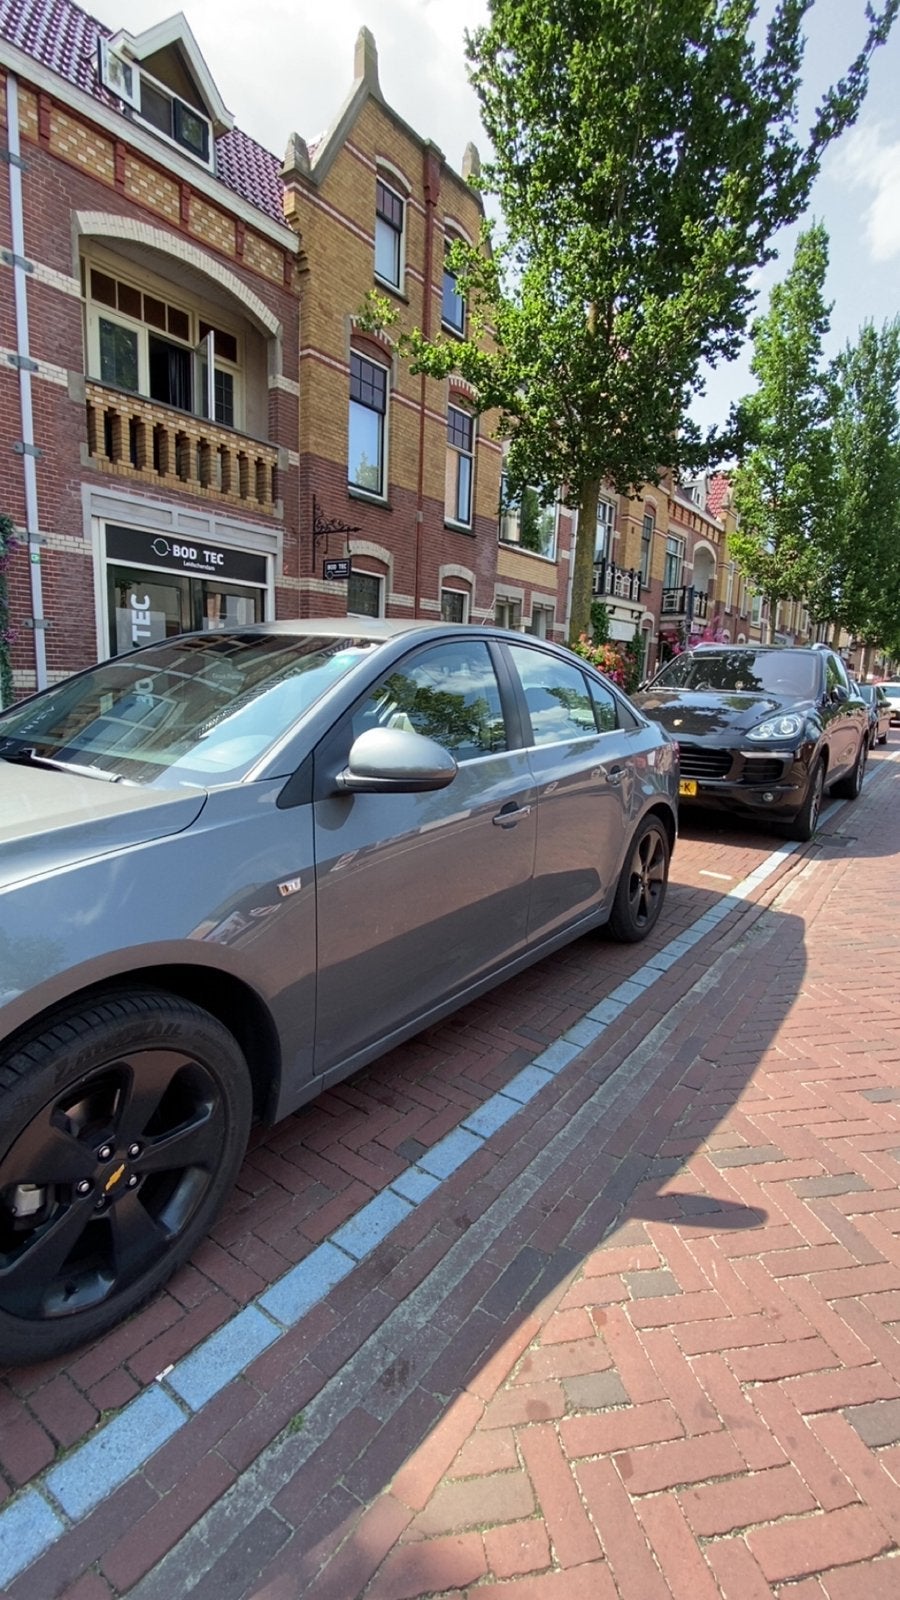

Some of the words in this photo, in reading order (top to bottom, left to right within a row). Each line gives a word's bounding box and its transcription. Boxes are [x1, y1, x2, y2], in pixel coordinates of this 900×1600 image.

[172, 544, 198, 560] BOD
[203, 550, 224, 565] TEC
[131, 594, 151, 641] TEC
